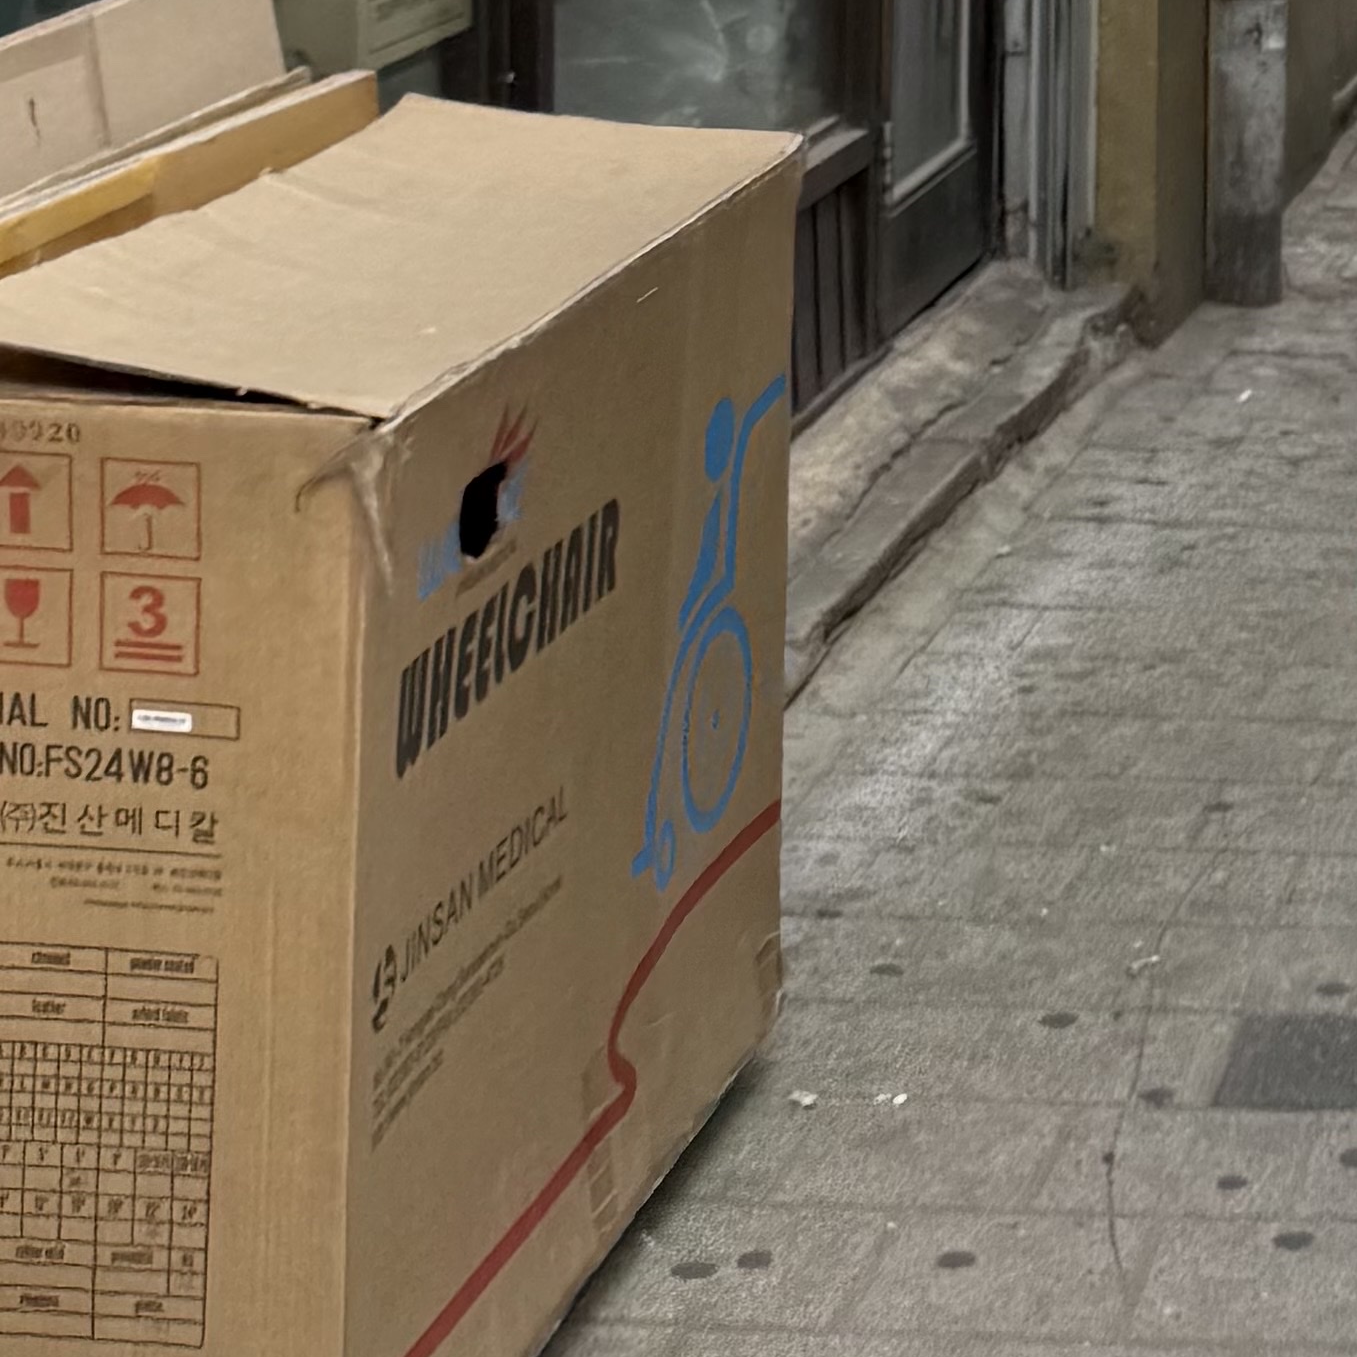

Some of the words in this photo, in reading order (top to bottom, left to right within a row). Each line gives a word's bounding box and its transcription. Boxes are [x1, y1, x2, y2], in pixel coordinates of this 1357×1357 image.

[127, 585, 168, 639] 3
[396, 498, 621, 779] WHEELCHAIR
[399, 873, 474, 984] JINSAN
